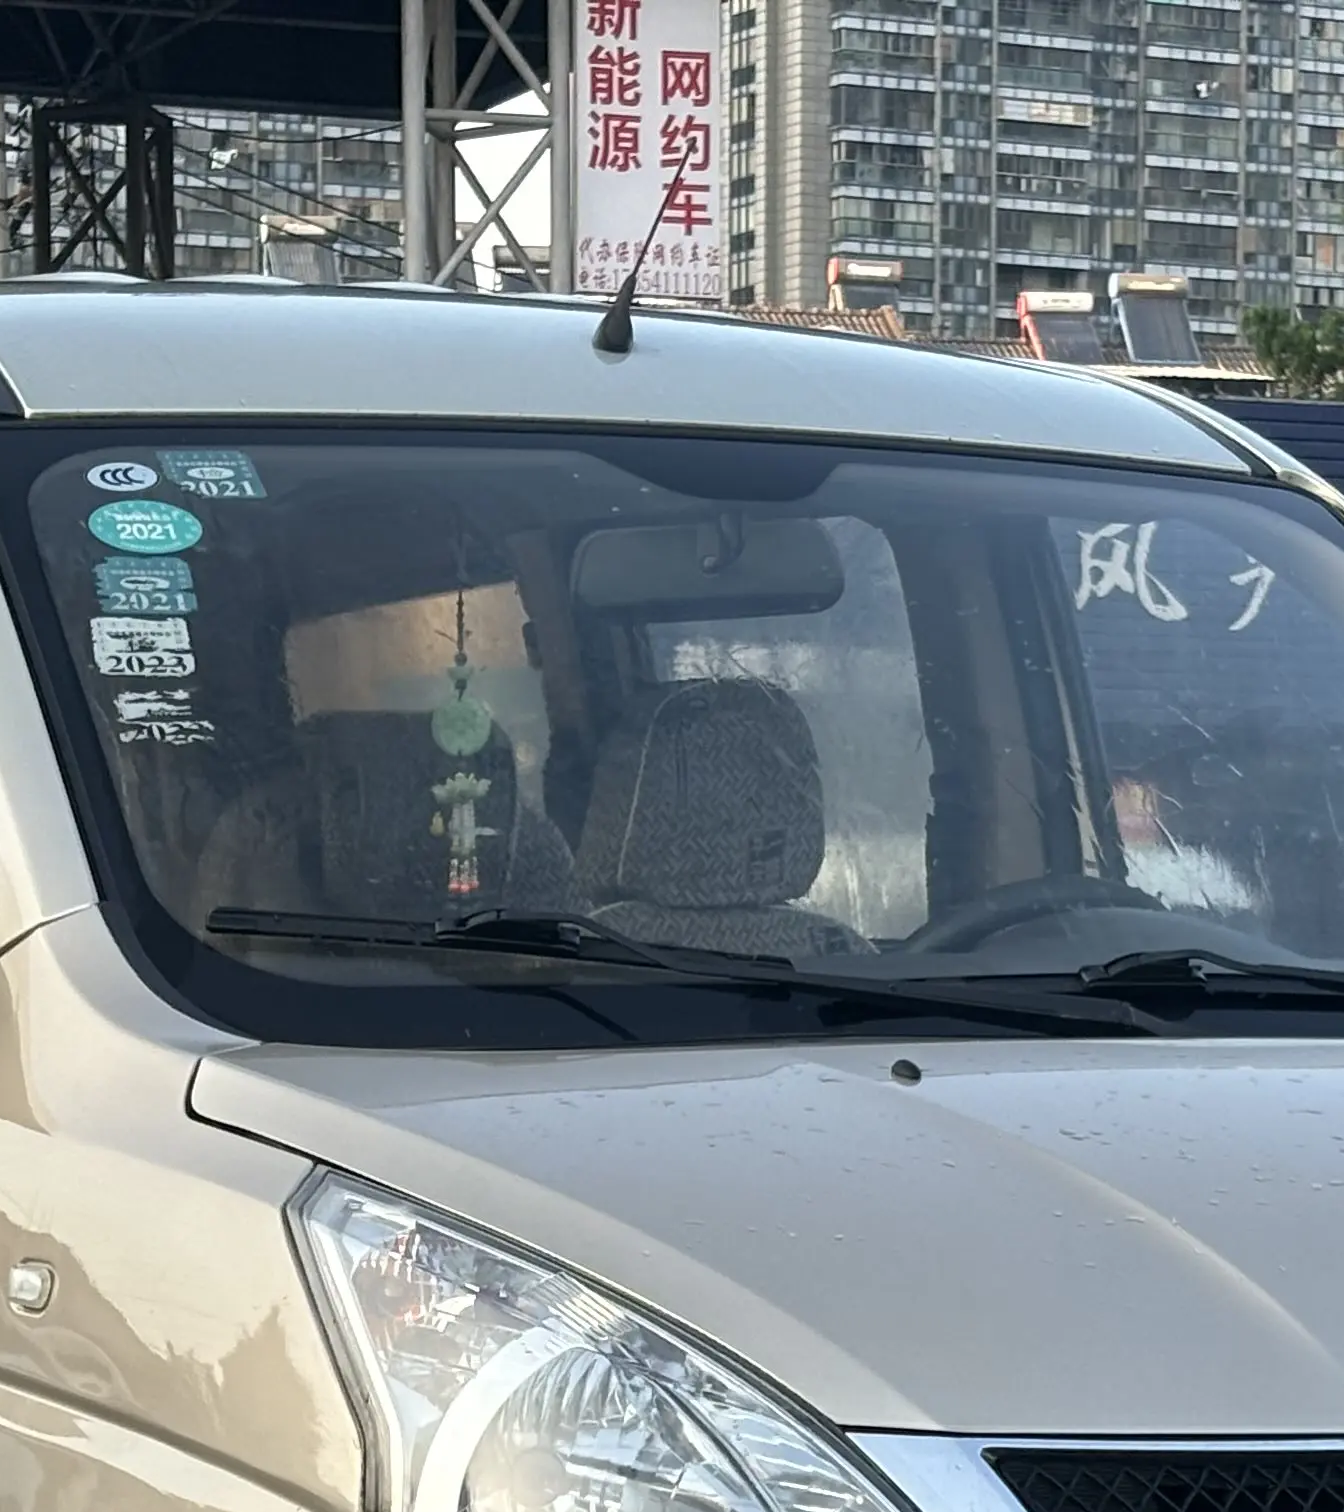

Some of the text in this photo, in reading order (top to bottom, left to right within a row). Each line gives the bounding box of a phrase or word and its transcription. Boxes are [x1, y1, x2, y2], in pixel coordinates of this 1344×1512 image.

[587, 0, 642, 172] 新能源
[660, 50, 713, 236] 网约车
[116, 522, 177, 541] 2021
[109, 591, 188, 611] 2021
